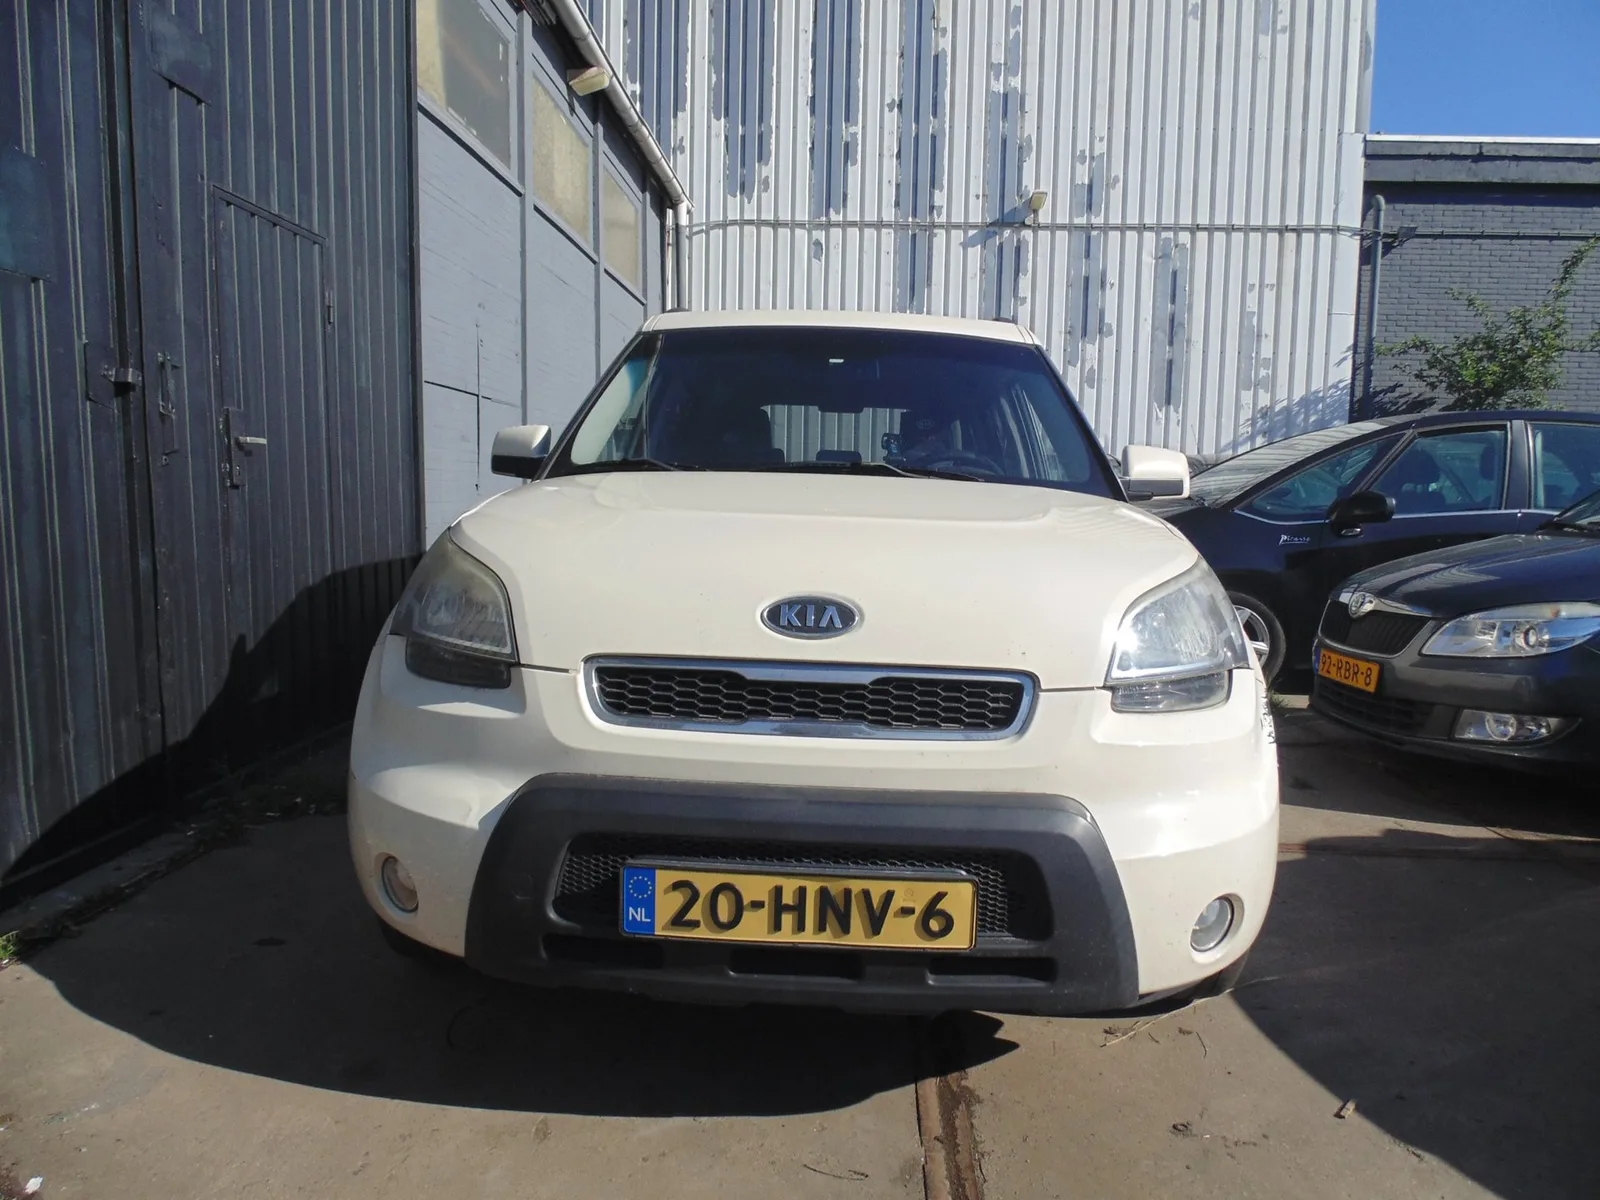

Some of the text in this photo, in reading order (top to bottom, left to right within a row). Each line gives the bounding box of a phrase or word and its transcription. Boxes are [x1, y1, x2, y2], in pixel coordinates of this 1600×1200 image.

[779, 604, 843, 628] KIA
[1321, 654, 1372, 687] 92-RBR-8
[628, 906, 651, 922] NL
[670, 879, 955, 939] 20-HNV-6
